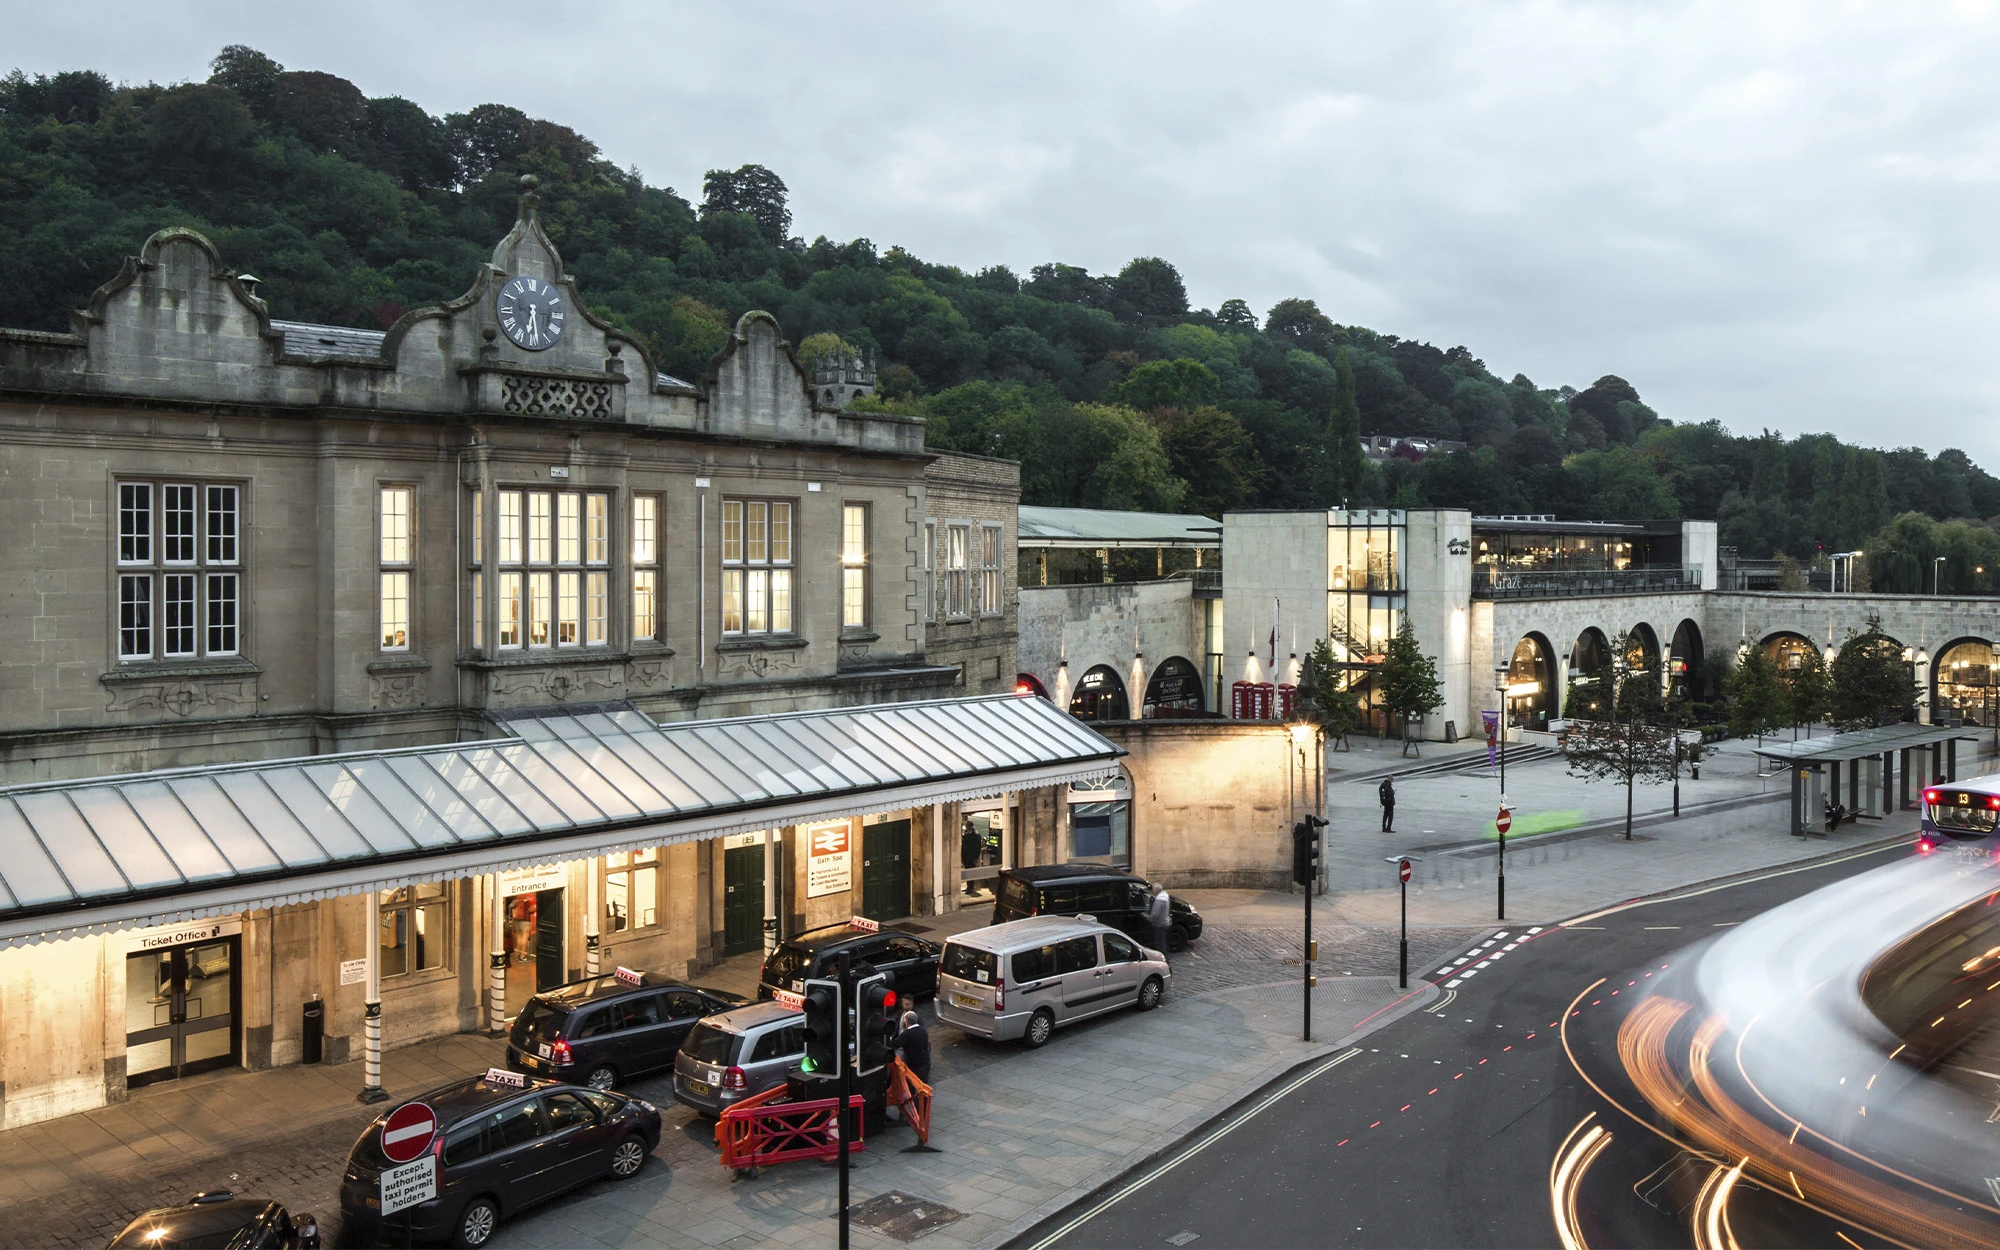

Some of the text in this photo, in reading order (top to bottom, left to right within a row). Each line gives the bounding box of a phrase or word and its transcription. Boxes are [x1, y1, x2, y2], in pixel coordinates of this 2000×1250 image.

[1494, 572, 1522, 590] Graze
[1959, 793, 1969, 804] 13
[512, 882, 546, 893] Entrance
[142, 930, 206, 947] Ticket Office
[620, 972, 636, 982] TAXI
[784, 995, 798, 1004] TAXI
[494, 1075, 516, 1084] TAXI
[393, 1162, 424, 1179] Except
[385, 1168, 432, 1191] authorised
[384, 1178, 433, 1201] taxi permit
[393, 1192, 426, 1208] holders
